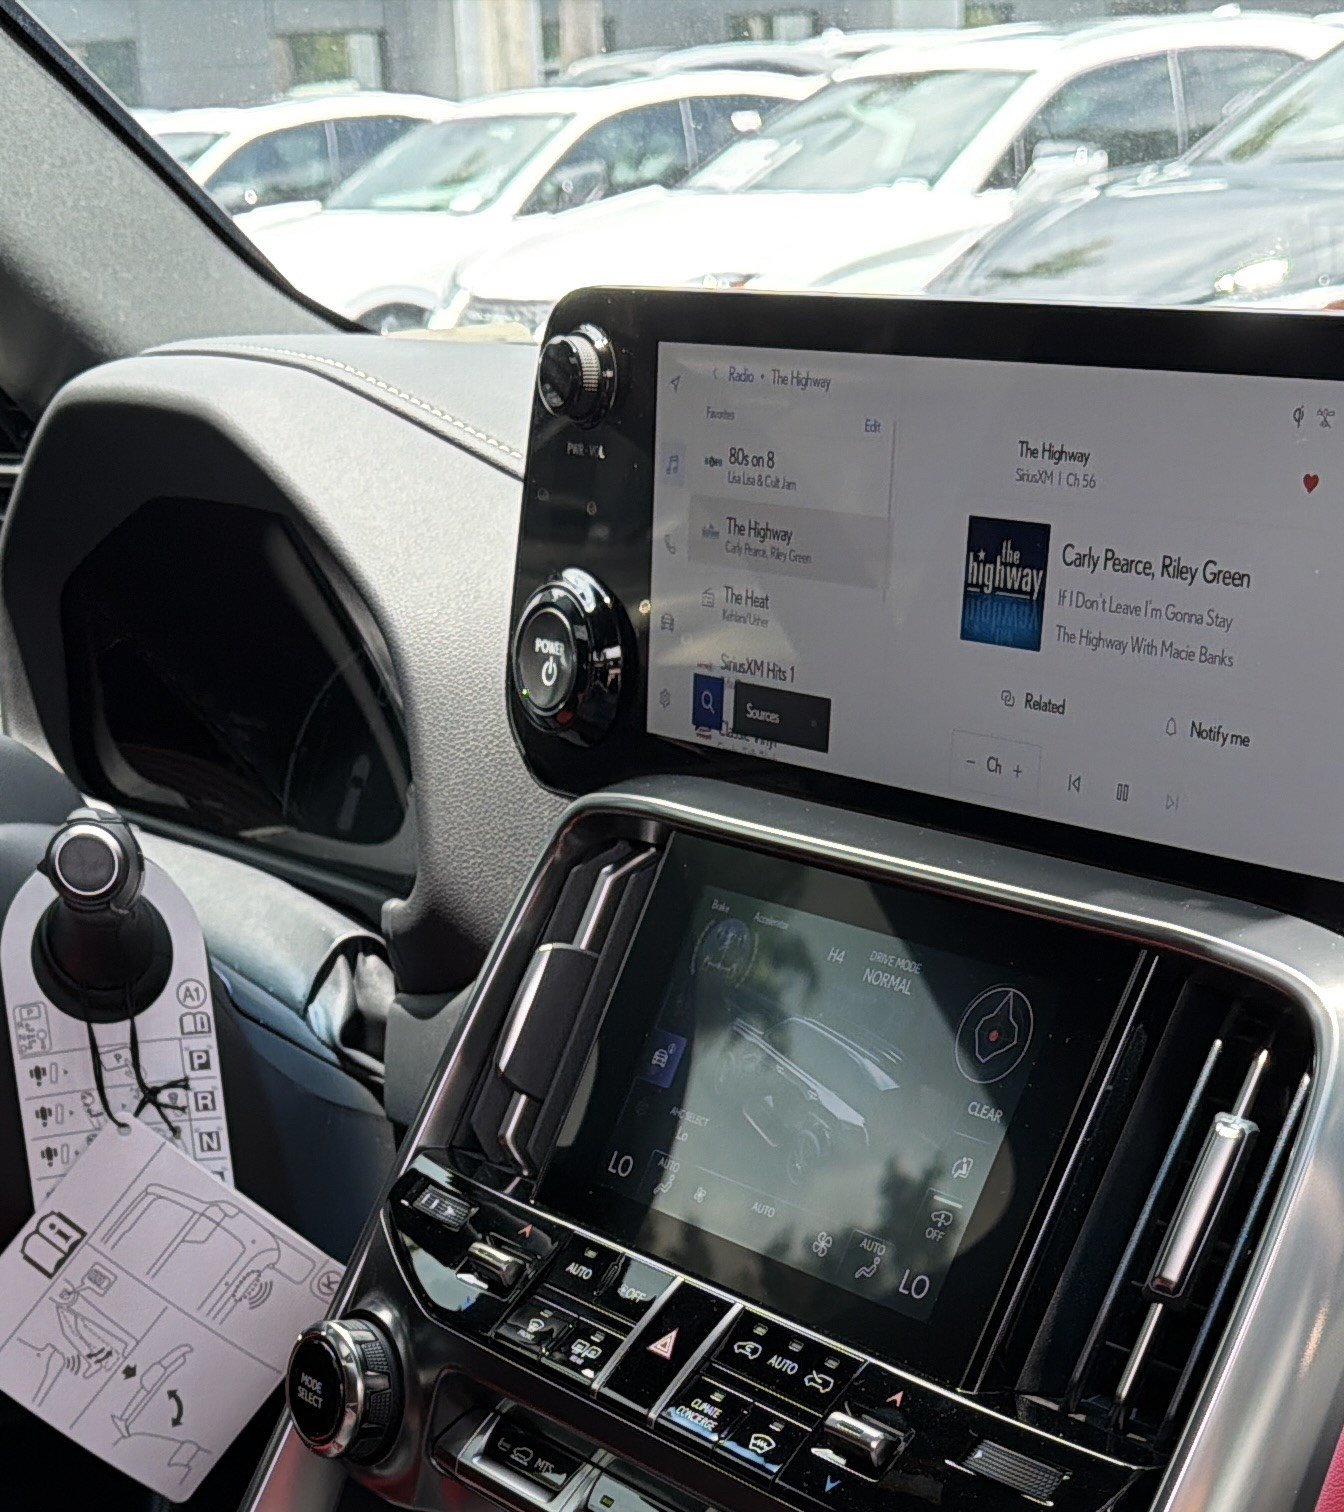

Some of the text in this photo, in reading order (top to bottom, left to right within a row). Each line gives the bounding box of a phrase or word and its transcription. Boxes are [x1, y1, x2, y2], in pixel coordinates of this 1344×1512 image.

[728, 366, 831, 391] Radio The Highway
[706, 406, 735, 421] Favorites
[864, 419, 881, 433] Edit
[728, 447, 749, 466] 80s
[751, 455, 764, 468] on
[766, 451, 775, 469] 8
[1018, 440, 1090, 468] The Highway
[728, 471, 797, 491] Lisa Lisa Cult Jam
[1015, 468, 1097, 489] SiriusXM Ch 56
[726, 516, 745, 537] The
[748, 519, 793, 546] Highway
[725, 540, 812, 565] Carly Green
[1002, 539, 1020, 564] the
[967, 551, 1044, 601] highway
[1062, 543, 1251, 589] Carly Pearce, Riley Green
[723, 585, 770, 611] The Heat
[1057, 588, 1233, 633] If Don't Leave I'm Gonna Stay
[535, 637, 566, 656] POWER
[1056, 625, 1234, 668] The Highway With Macie Banks
[720, 652, 764, 678] SiriusXM
[766, 661, 787, 683] Hits
[789, 665, 796, 684] 1
[746, 702, 781, 725] Sources
[1024, 691, 1066, 716] Related
[1189, 720, 1251, 748] Notify me
[986, 756, 1002, 775] Ch
[827, 947, 846, 964] H4
[869, 950, 923, 975] DRIVE MODE
[862, 968, 912, 996] NORMAL
[183, 985, 201, 1002] A1
[967, 1101, 1003, 1123] CLEAR
[675, 1126, 689, 1142] Lo
[608, 1150, 634, 1177] LO
[658, 1156, 681, 1173] AUTO
[751, 1202, 776, 1218] AUTO
[925, 1227, 945, 1243] OFF
[859, 1238, 886, 1256] AUTO
[565, 1262, 593, 1280] AUTO
[899, 1268, 930, 1299] LO
[626, 1286, 647, 1304] OFF
[766, 1354, 799, 1375] AUTO
[301, 1372, 323, 1394] MODE
[297, 1385, 323, 1409] SELECT
[676, 1405, 719, 1432] CONCIERGE
[691, 1398, 723, 1419] CLIMATE
[533, 1457, 555, 1475] MTS
